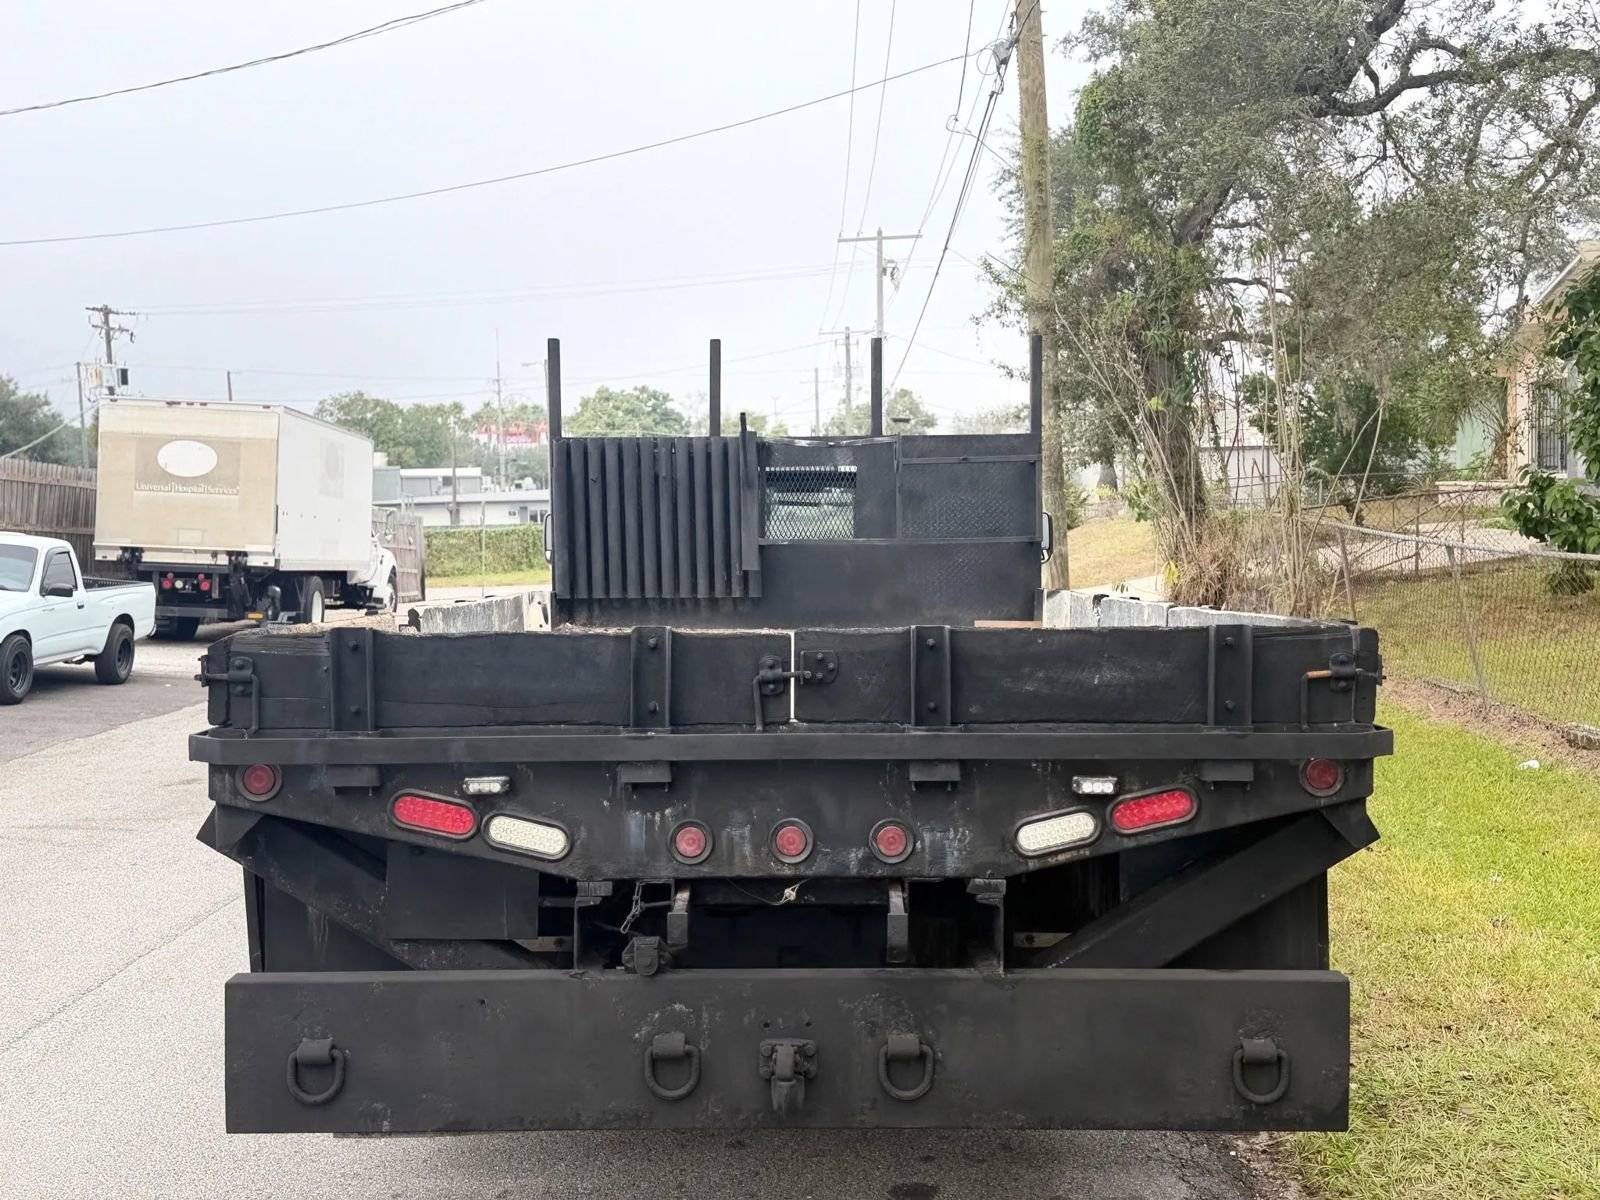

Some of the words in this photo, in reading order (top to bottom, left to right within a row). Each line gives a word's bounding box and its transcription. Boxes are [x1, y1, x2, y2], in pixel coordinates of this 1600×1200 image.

[136, 481, 171, 492] Universal
[174, 482, 204, 495] Hospital
[207, 484, 238, 495] Services
